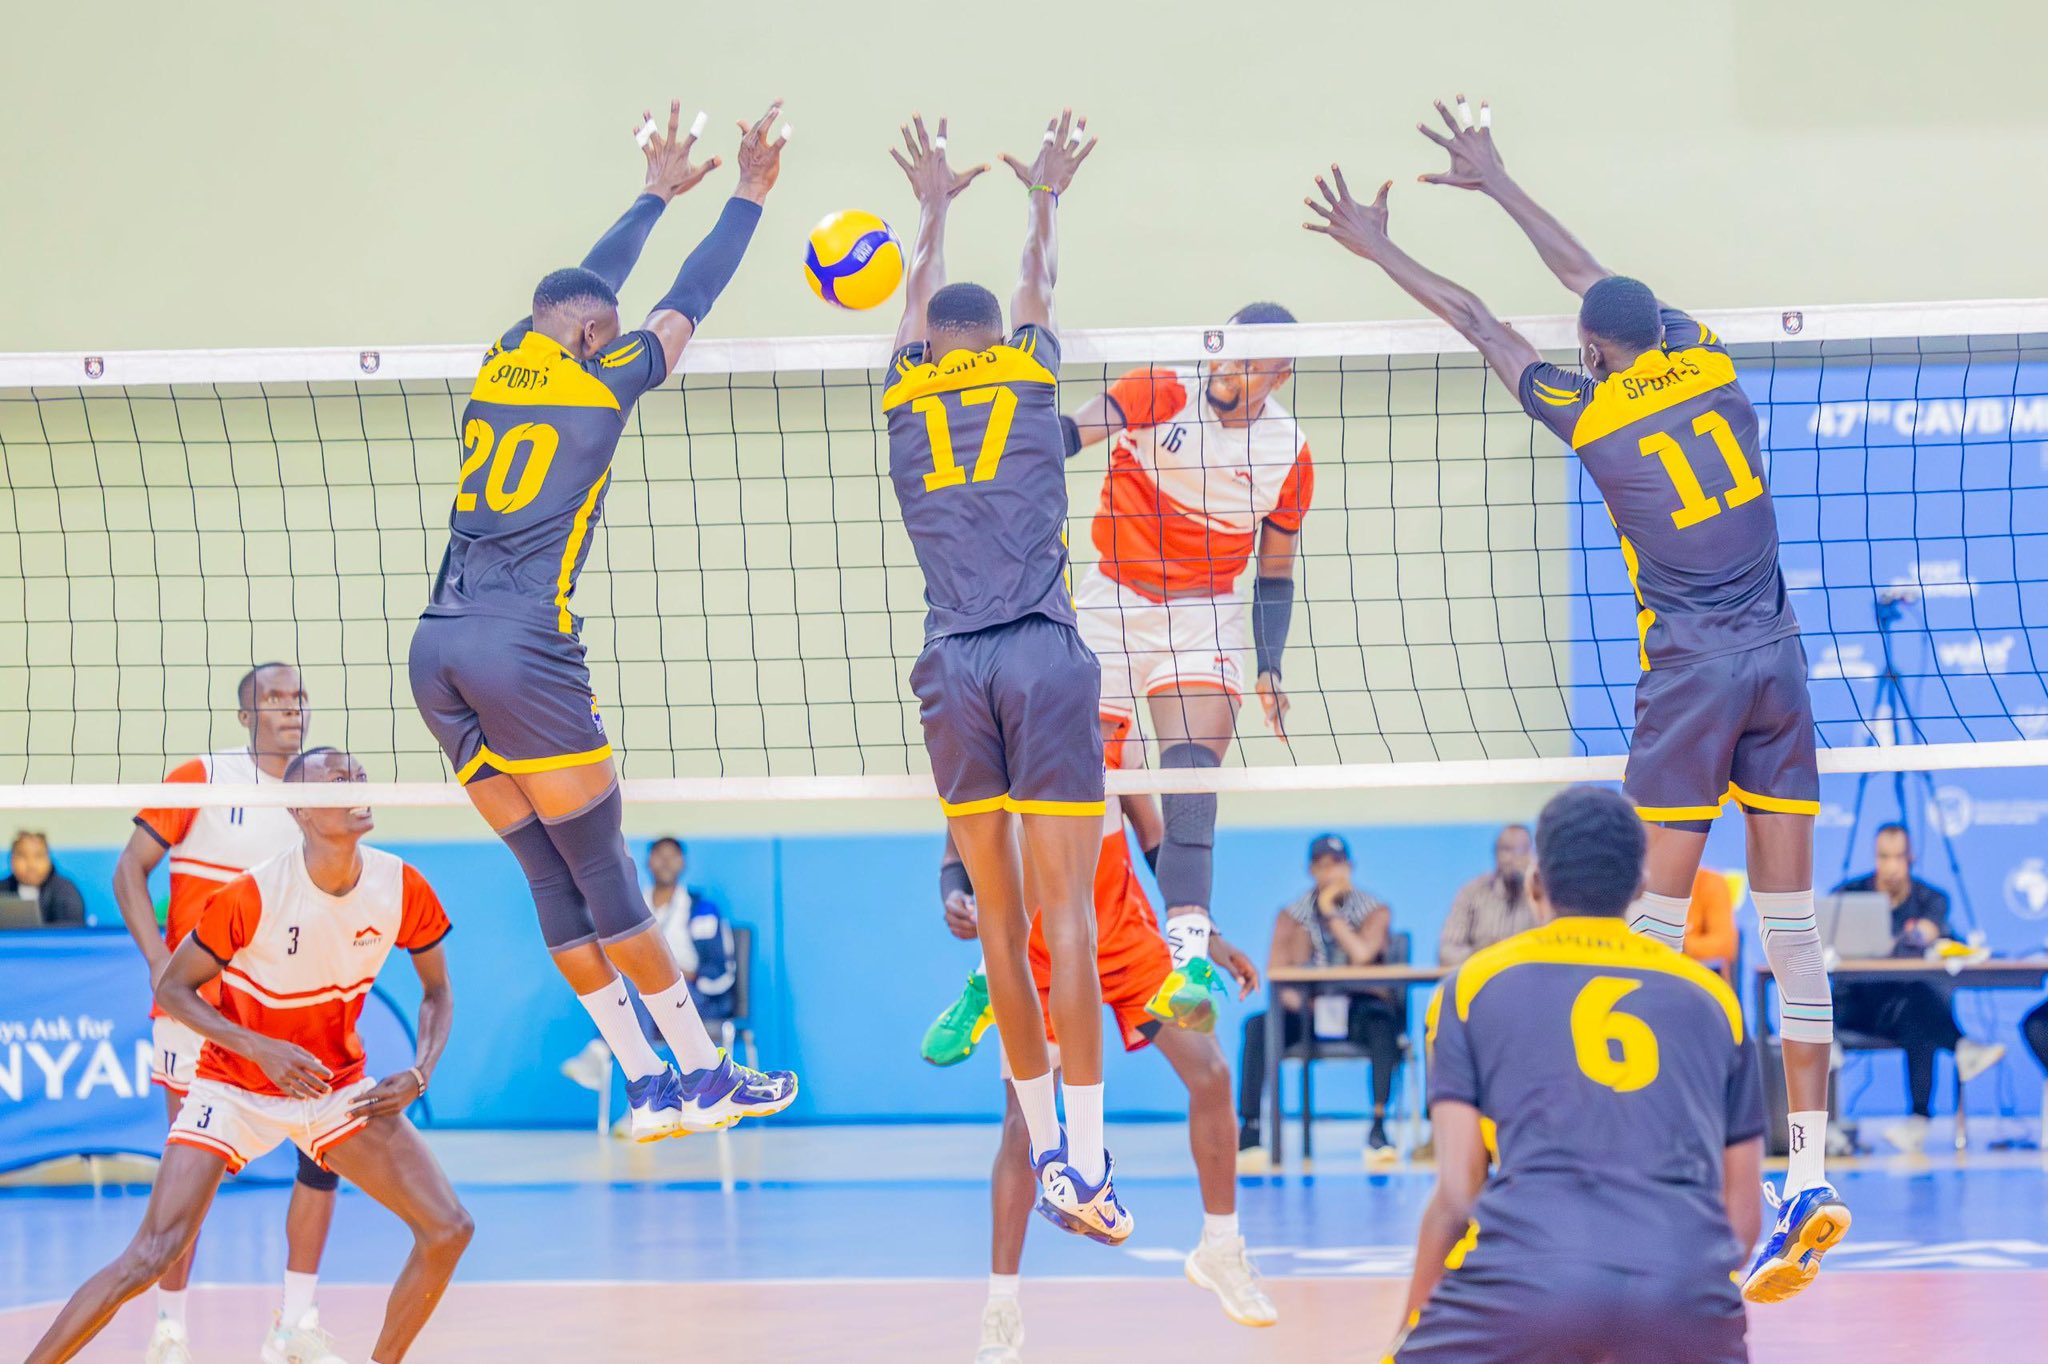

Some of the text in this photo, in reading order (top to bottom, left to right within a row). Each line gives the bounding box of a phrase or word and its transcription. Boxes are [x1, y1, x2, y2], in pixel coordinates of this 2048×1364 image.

[1894, 398, 2003, 436] CAVB
[912, 386, 1018, 493] 17
[1161, 423, 1187, 453] 16
[457, 418, 560, 514] 20
[1638, 410, 1764, 530] 11
[287, 926, 300, 955] 3
[31, 1014, 73, 1041] Ask
[1570, 975, 1660, 1092] 6
[164, 1050, 177, 1077] 11
[197, 1104, 213, 1129] 3
